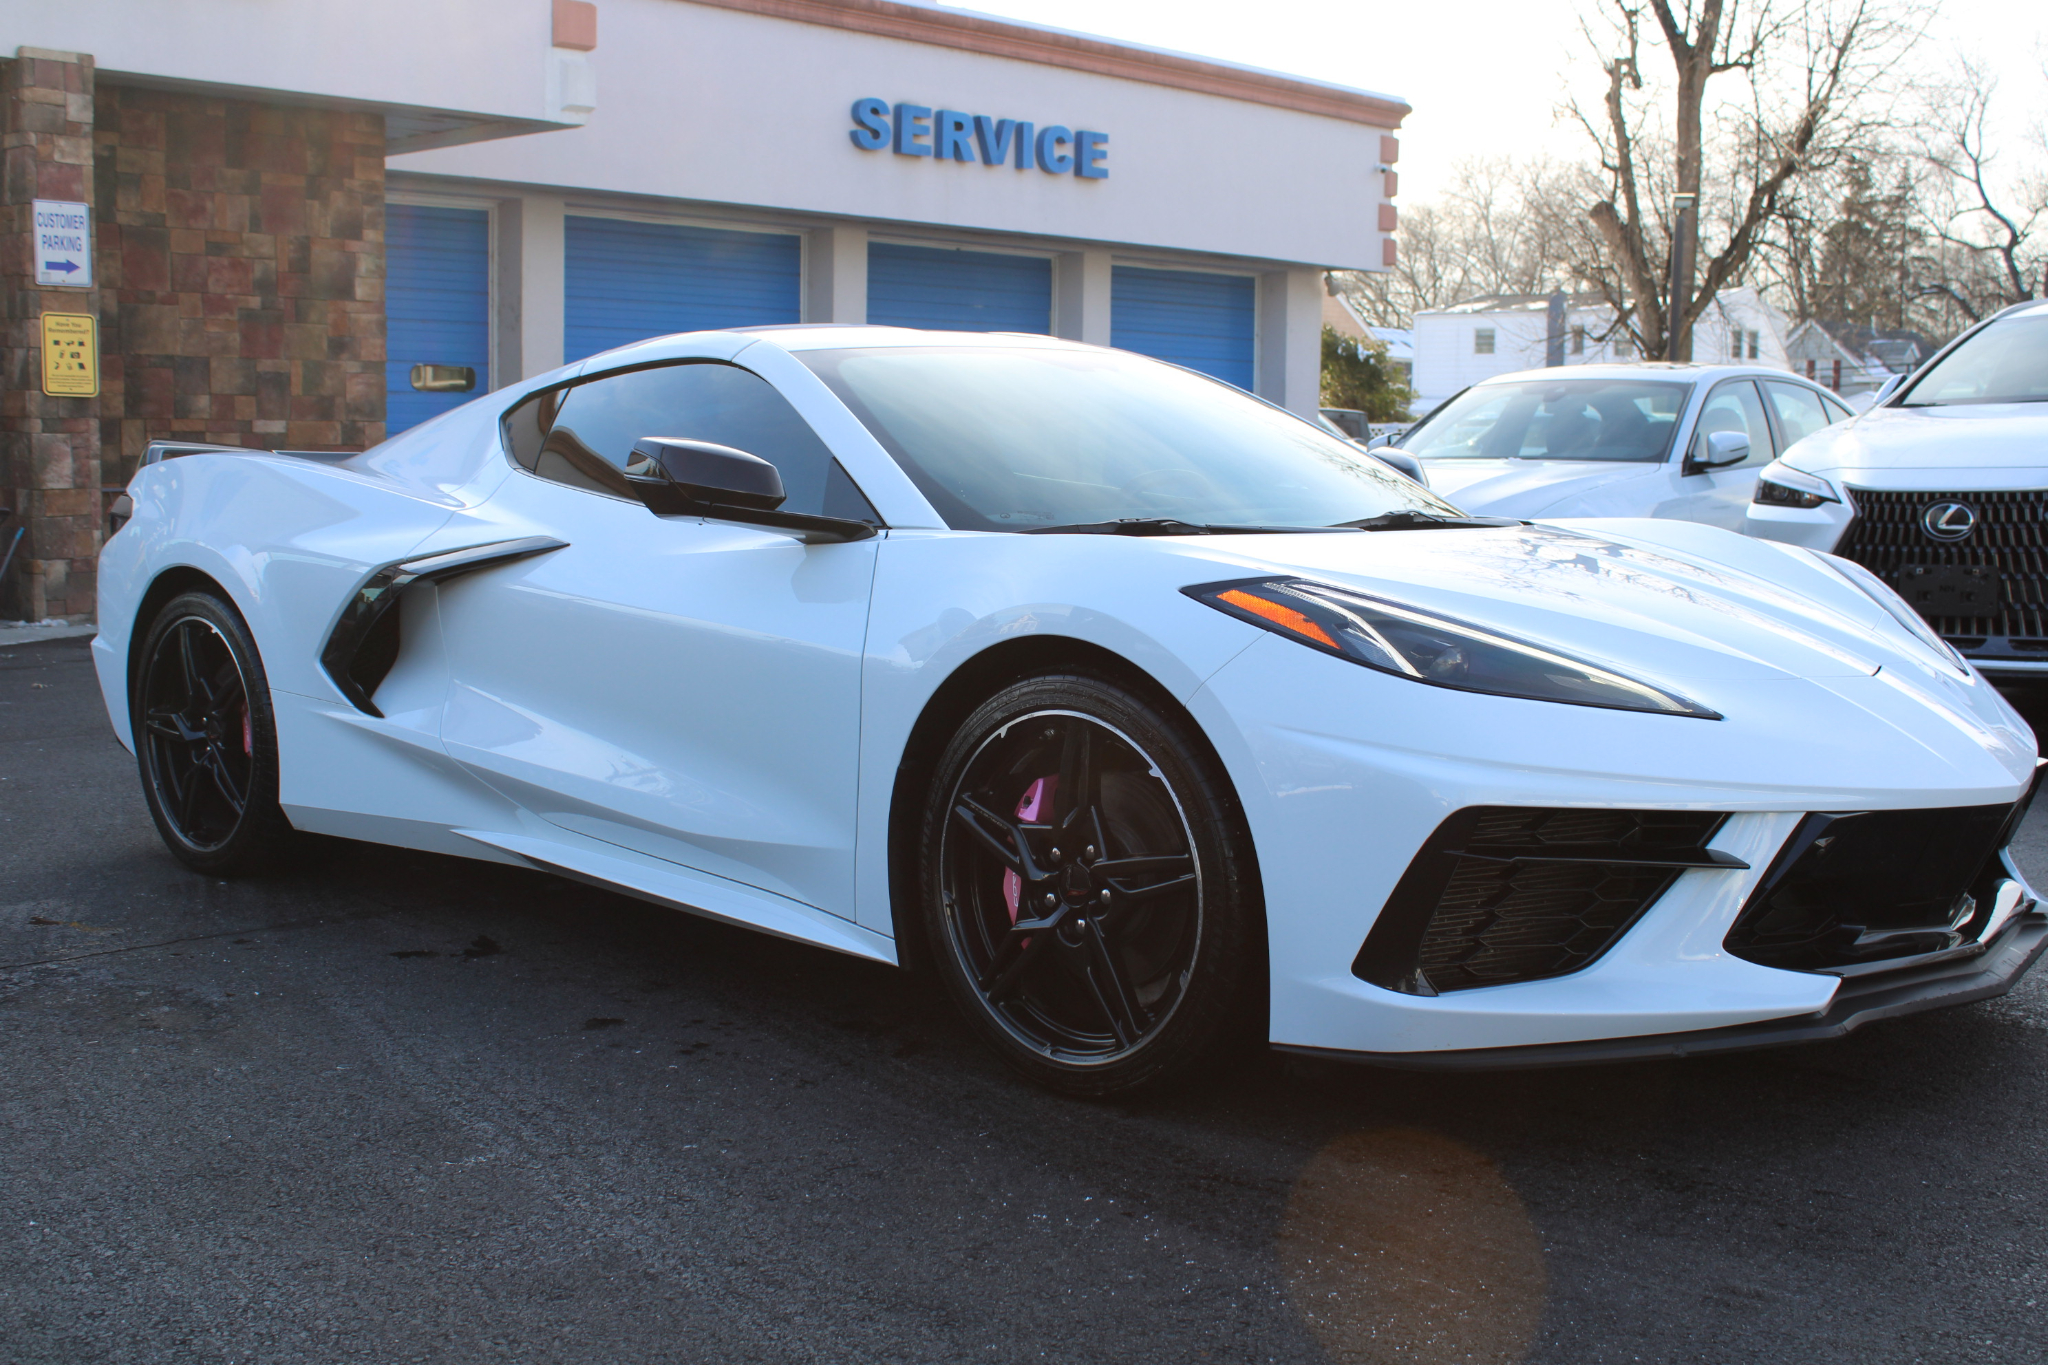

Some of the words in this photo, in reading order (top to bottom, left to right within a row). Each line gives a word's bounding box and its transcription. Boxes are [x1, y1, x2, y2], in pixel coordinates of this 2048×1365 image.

[849, 97, 1109, 179] SERVICE
[37, 211, 85, 230] CUSTOMER
[42, 234, 82, 252] PARKING
